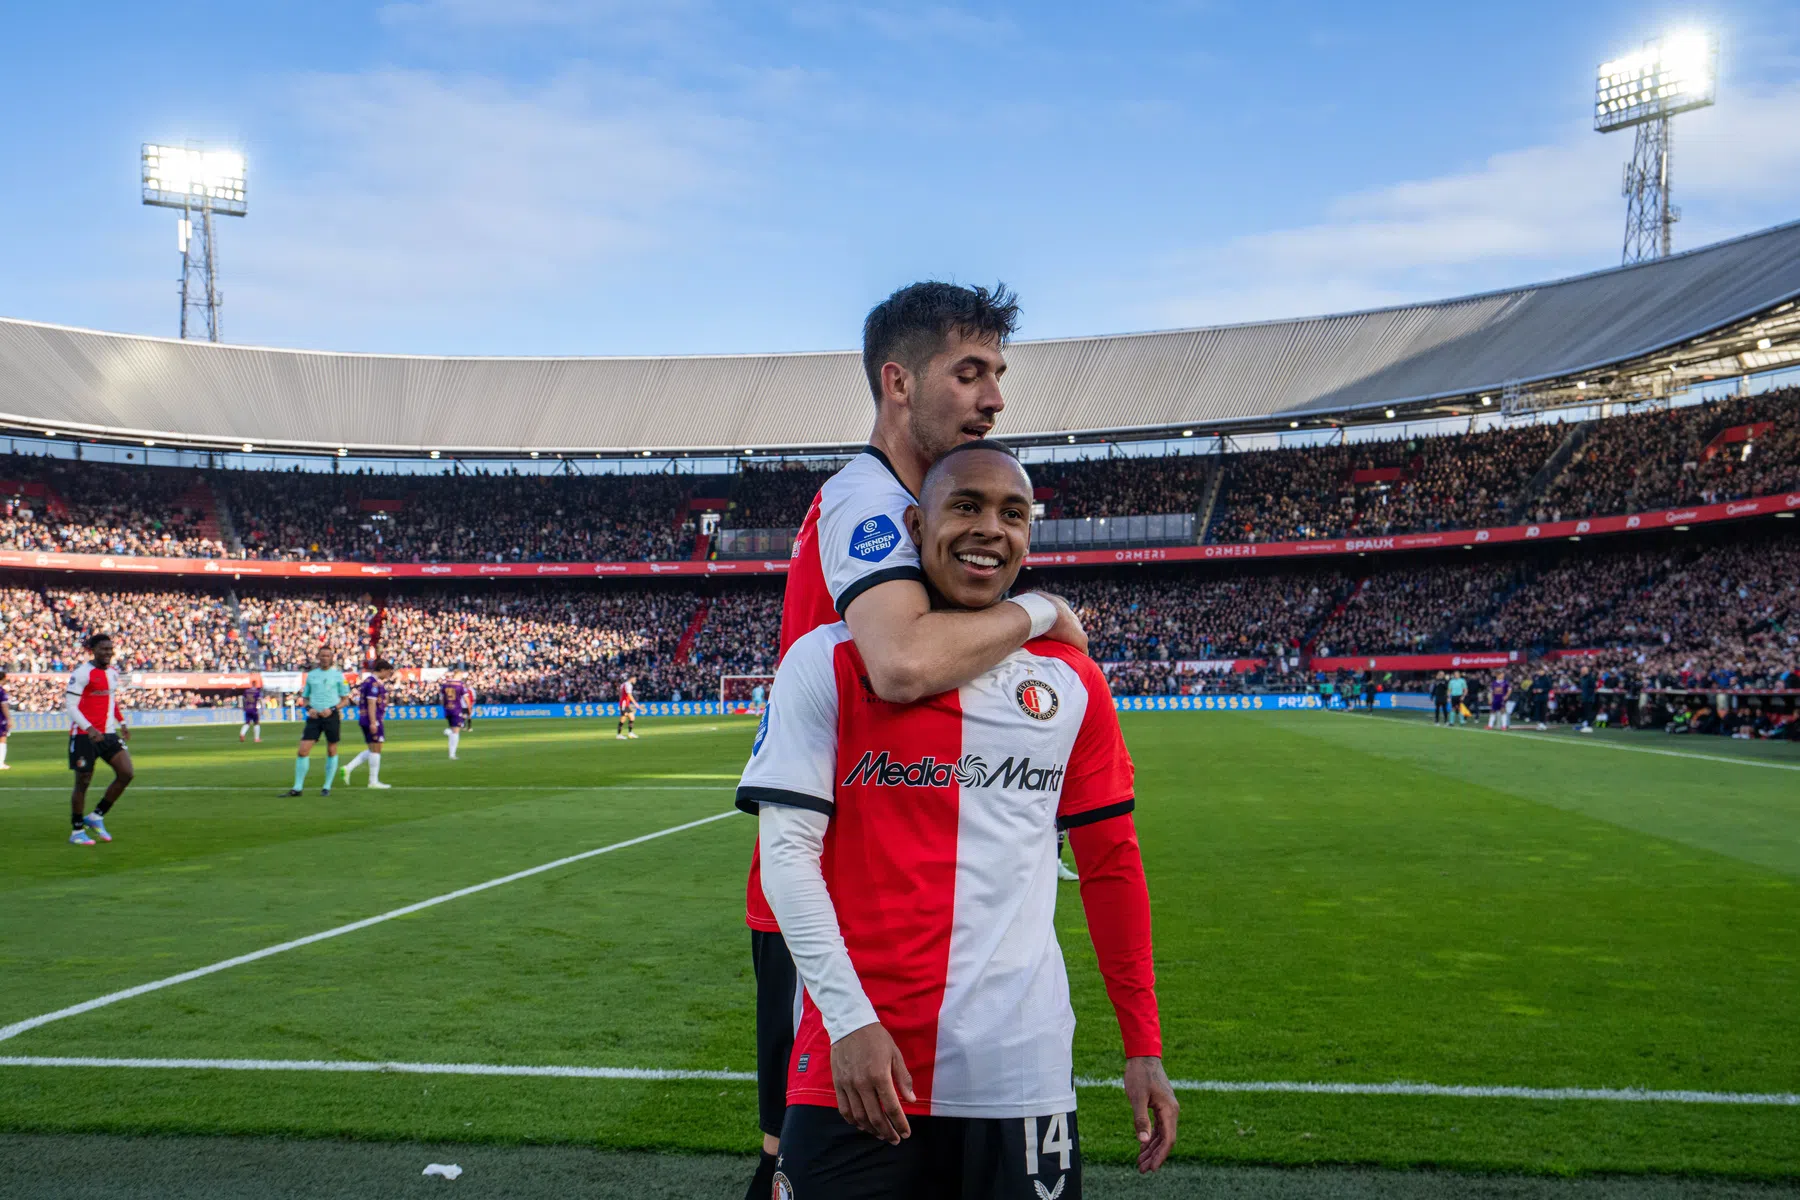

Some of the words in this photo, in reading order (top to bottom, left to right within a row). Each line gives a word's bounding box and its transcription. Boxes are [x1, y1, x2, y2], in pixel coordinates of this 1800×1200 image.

[854, 533, 895, 551] VRIENDEN
[860, 542, 891, 556] LOTERIJ
[1345, 538, 1394, 551] SPAUX
[1017, 680, 1054, 695] FEYENOORD
[1021, 703, 1058, 720] ROTTERDAM
[842, 751, 953, 787] Media
[982, 756, 1063, 792] Markt
[1024, 1113, 1073, 1175] 14
